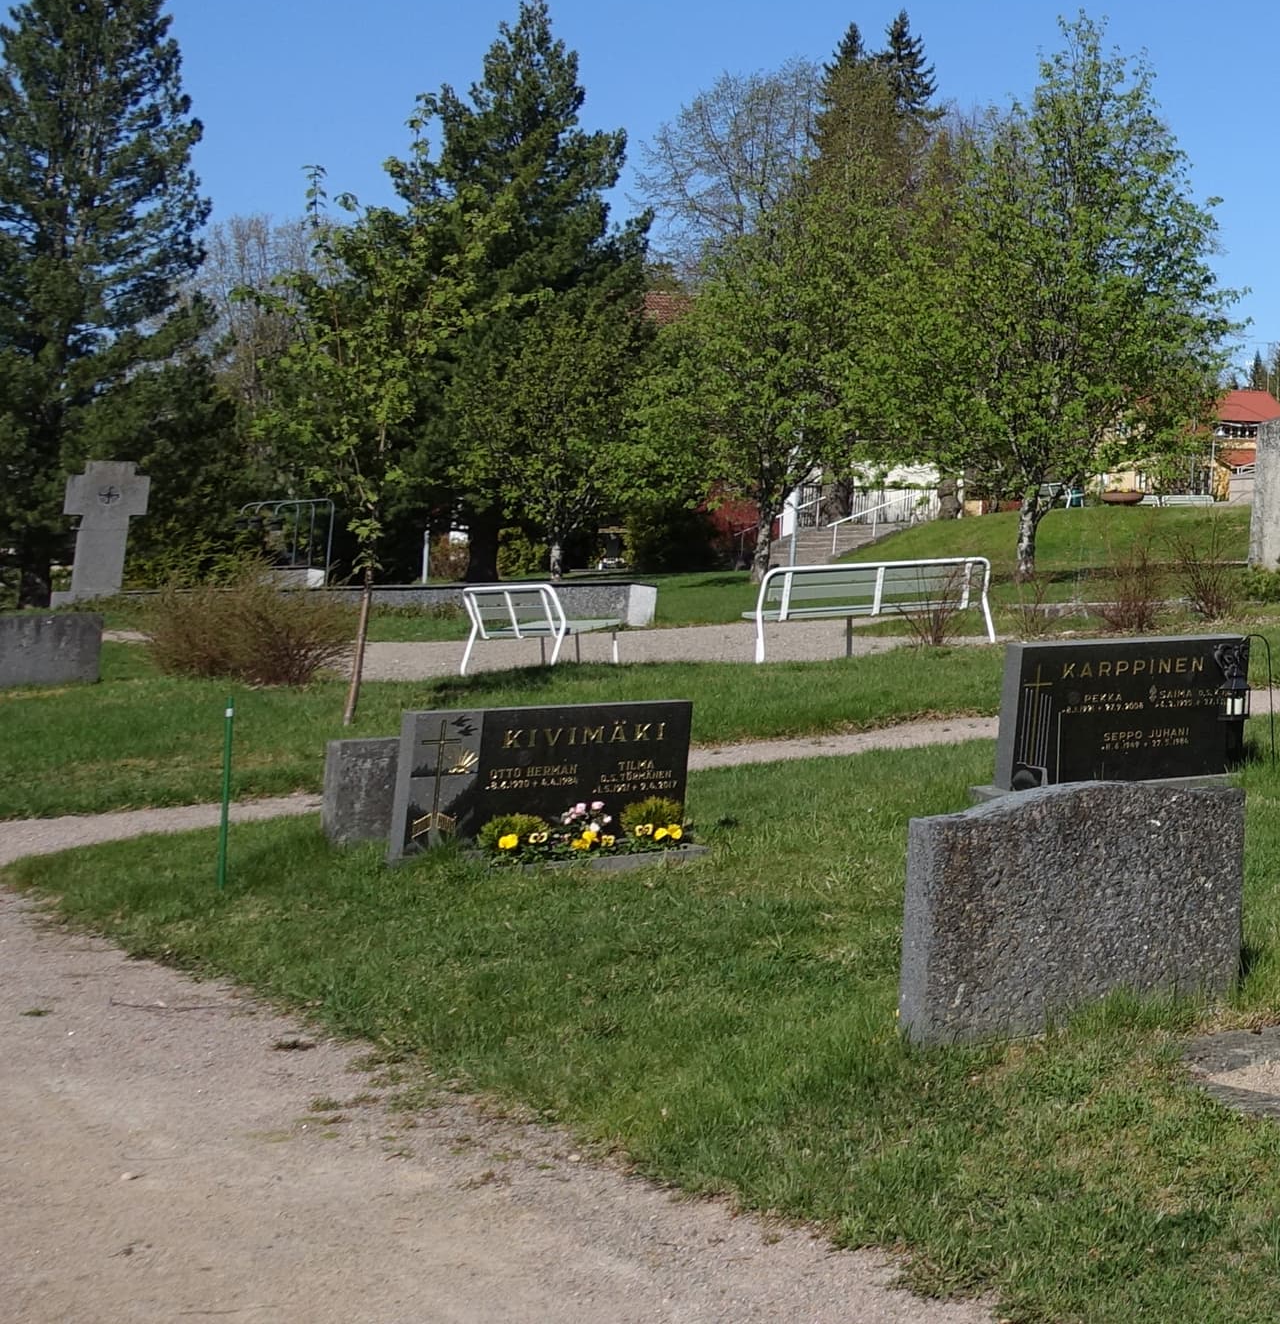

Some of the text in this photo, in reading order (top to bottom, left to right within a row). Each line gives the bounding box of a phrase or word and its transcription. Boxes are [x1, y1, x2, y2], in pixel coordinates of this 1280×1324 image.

[1062, 656, 1205, 679] KARPPINEN
[1084, 692, 1122, 703] PEKKA
[1159, 688, 1193, 698] SAIMA
[501, 720, 667, 749] KIVIMÄKI
[1103, 727, 1190, 742] SEPPO JUHANI
[490, 764, 579, 780] OTTO HERMAN
